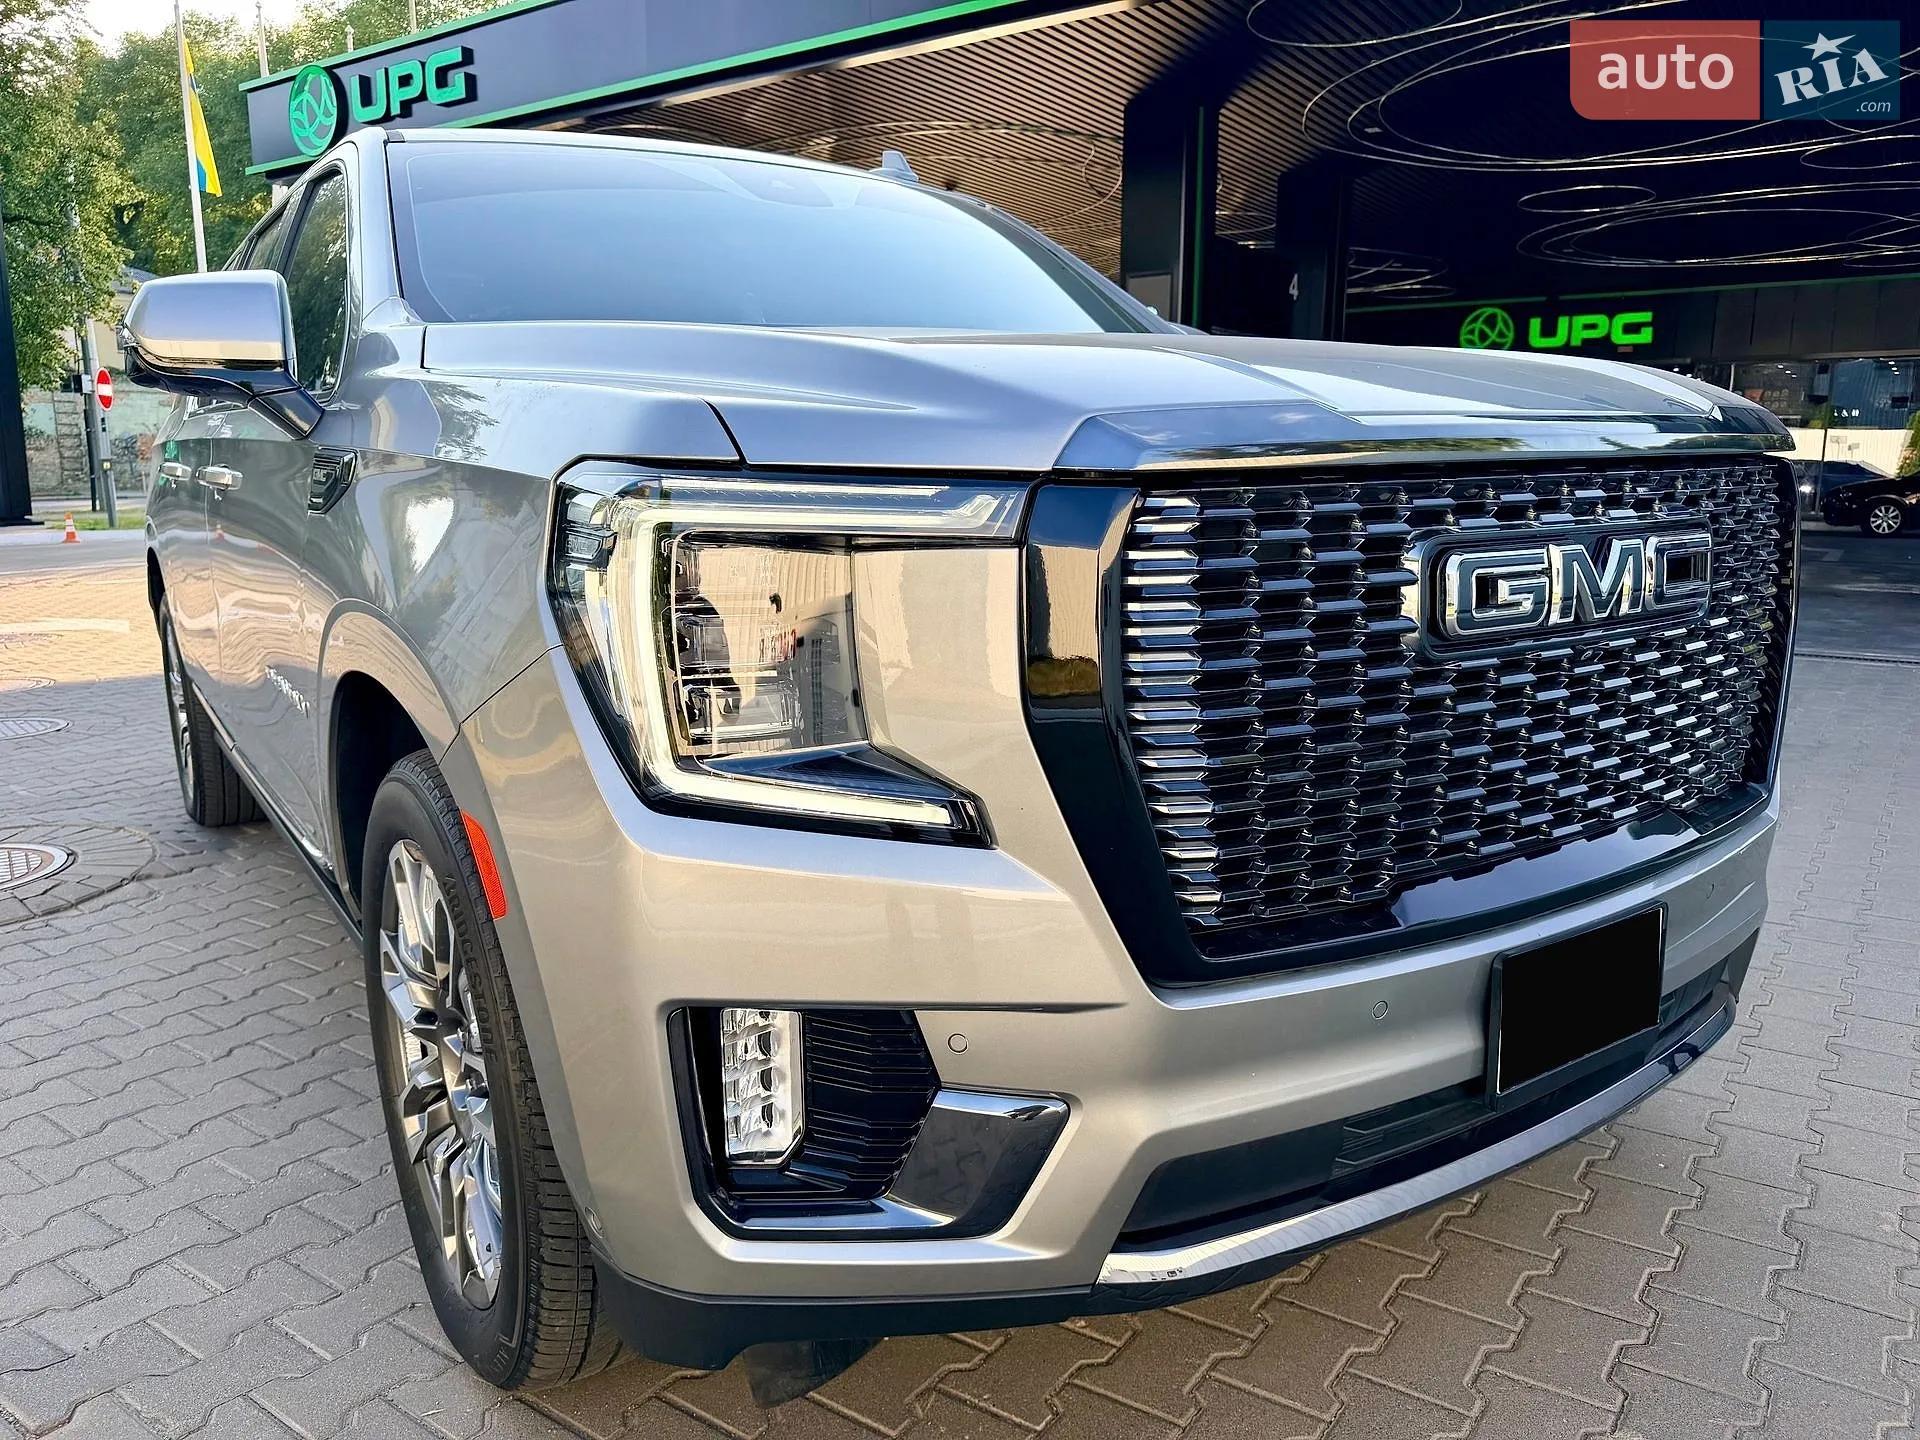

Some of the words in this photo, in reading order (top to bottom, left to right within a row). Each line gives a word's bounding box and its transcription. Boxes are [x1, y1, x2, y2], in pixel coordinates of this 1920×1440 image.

[351, 45, 470, 124] UPG
[1288, 272, 1299, 301] 4
[1528, 311, 1653, 348] UPG
[1446, 532, 1712, 636] GMC
